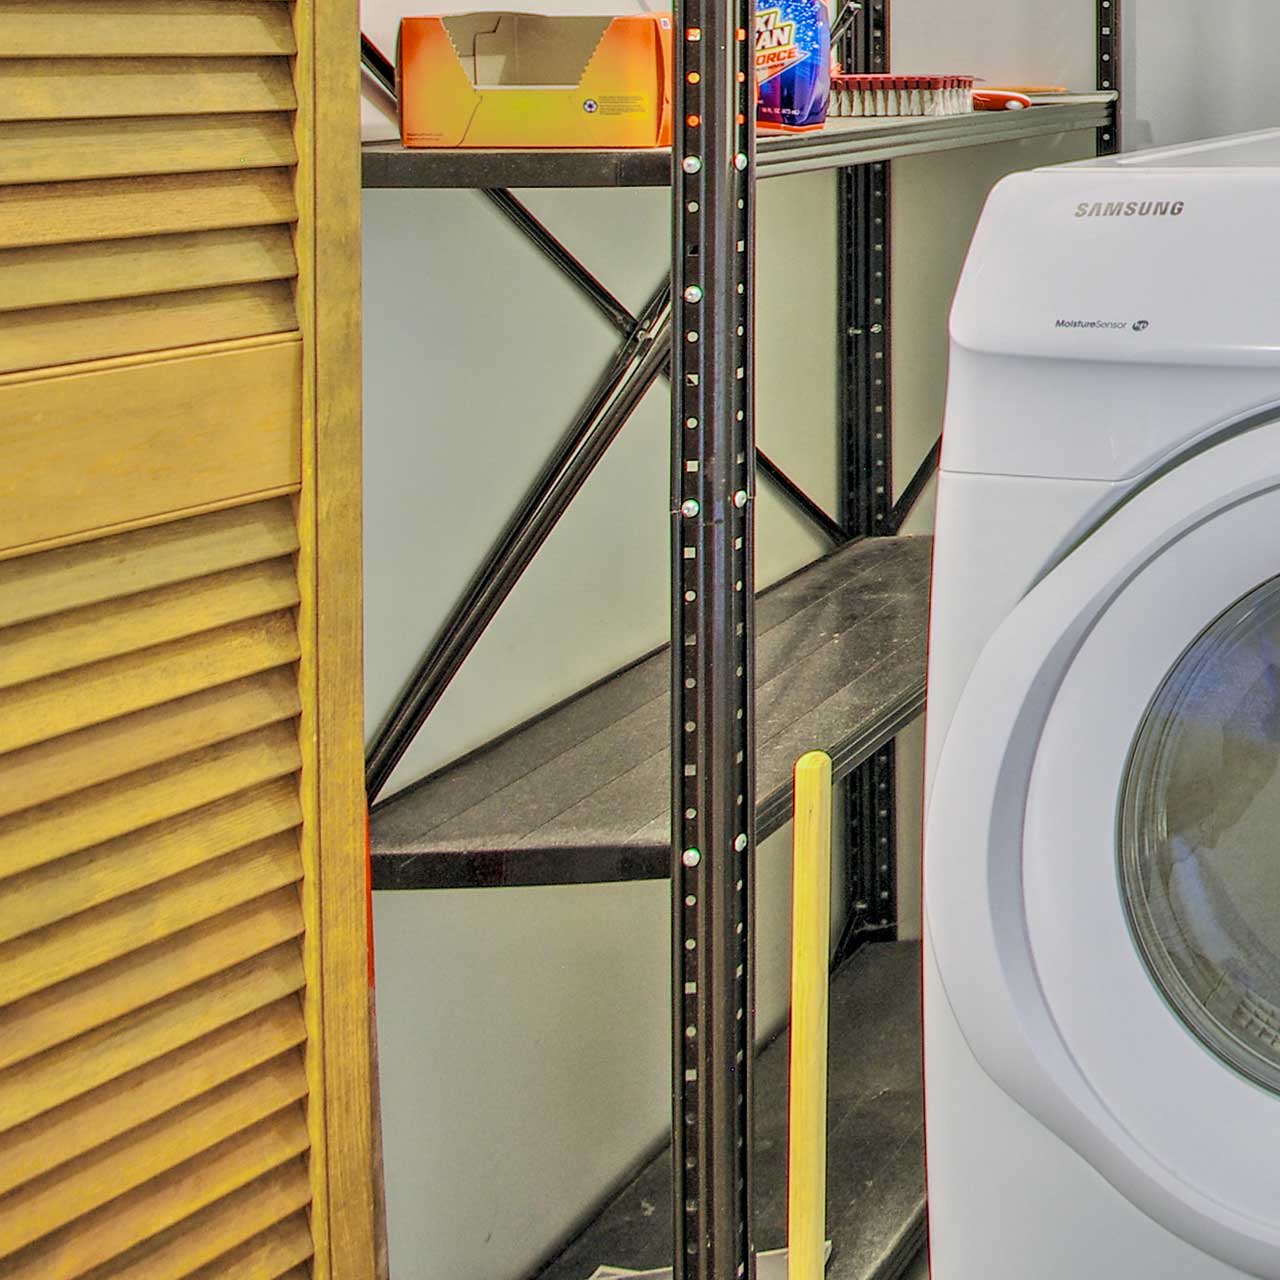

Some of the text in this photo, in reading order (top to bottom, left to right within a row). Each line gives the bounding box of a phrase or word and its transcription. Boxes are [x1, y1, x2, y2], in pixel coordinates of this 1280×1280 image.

[755, 13, 777, 32] XI
[755, 47, 797, 67] ORCE
[1074, 200, 1185, 218] SAMSUNG
